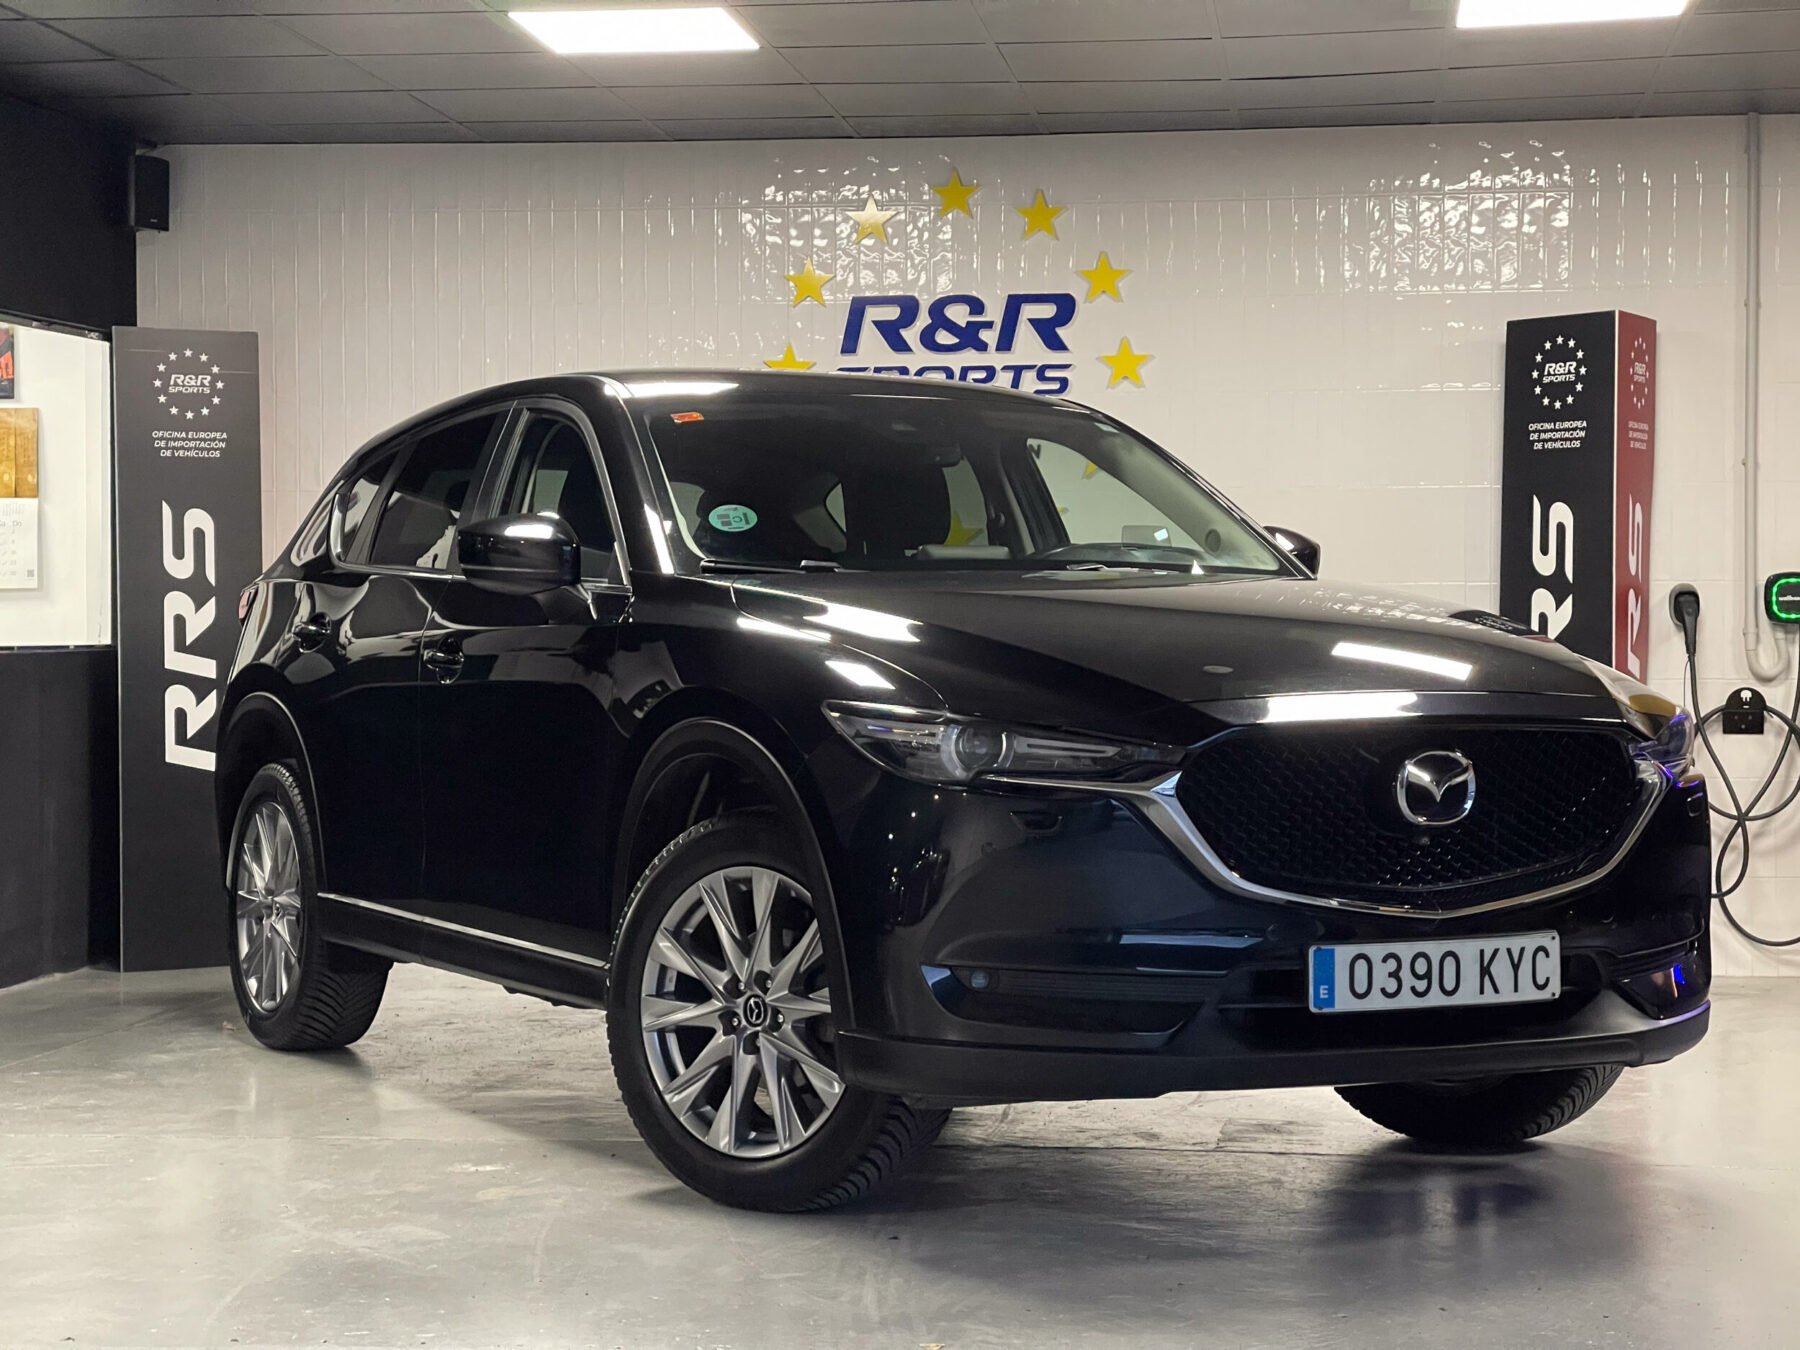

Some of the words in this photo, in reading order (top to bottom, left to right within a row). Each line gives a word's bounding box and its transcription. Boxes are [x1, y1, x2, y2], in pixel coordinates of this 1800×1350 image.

[840, 293, 1077, 354] R&R
[1544, 361, 1577, 376] R&R
[170, 374, 211, 386] R&R
[836, 363, 1073, 395] RTS
[1542, 374, 1576, 383] SPORTS
[1528, 422, 1555, 431] OFICINA
[1555, 420, 1587, 429] EUROPEA
[1540, 429, 1586, 439] IMPORTACIÓN
[154, 440, 166, 448] DE
[168, 440, 226, 449] IMPORTACIÓN
[1533, 442, 1543, 450] DE
[1544, 440, 1581, 449] VEHÍCULOS
[174, 449, 221, 458] VEHÍCULOS
[162, 500, 217, 772] RRS
[1349, 951, 1461, 1000] 0390
[1479, 945, 1550, 995] KYC
[1319, 985, 1329, 999] E
